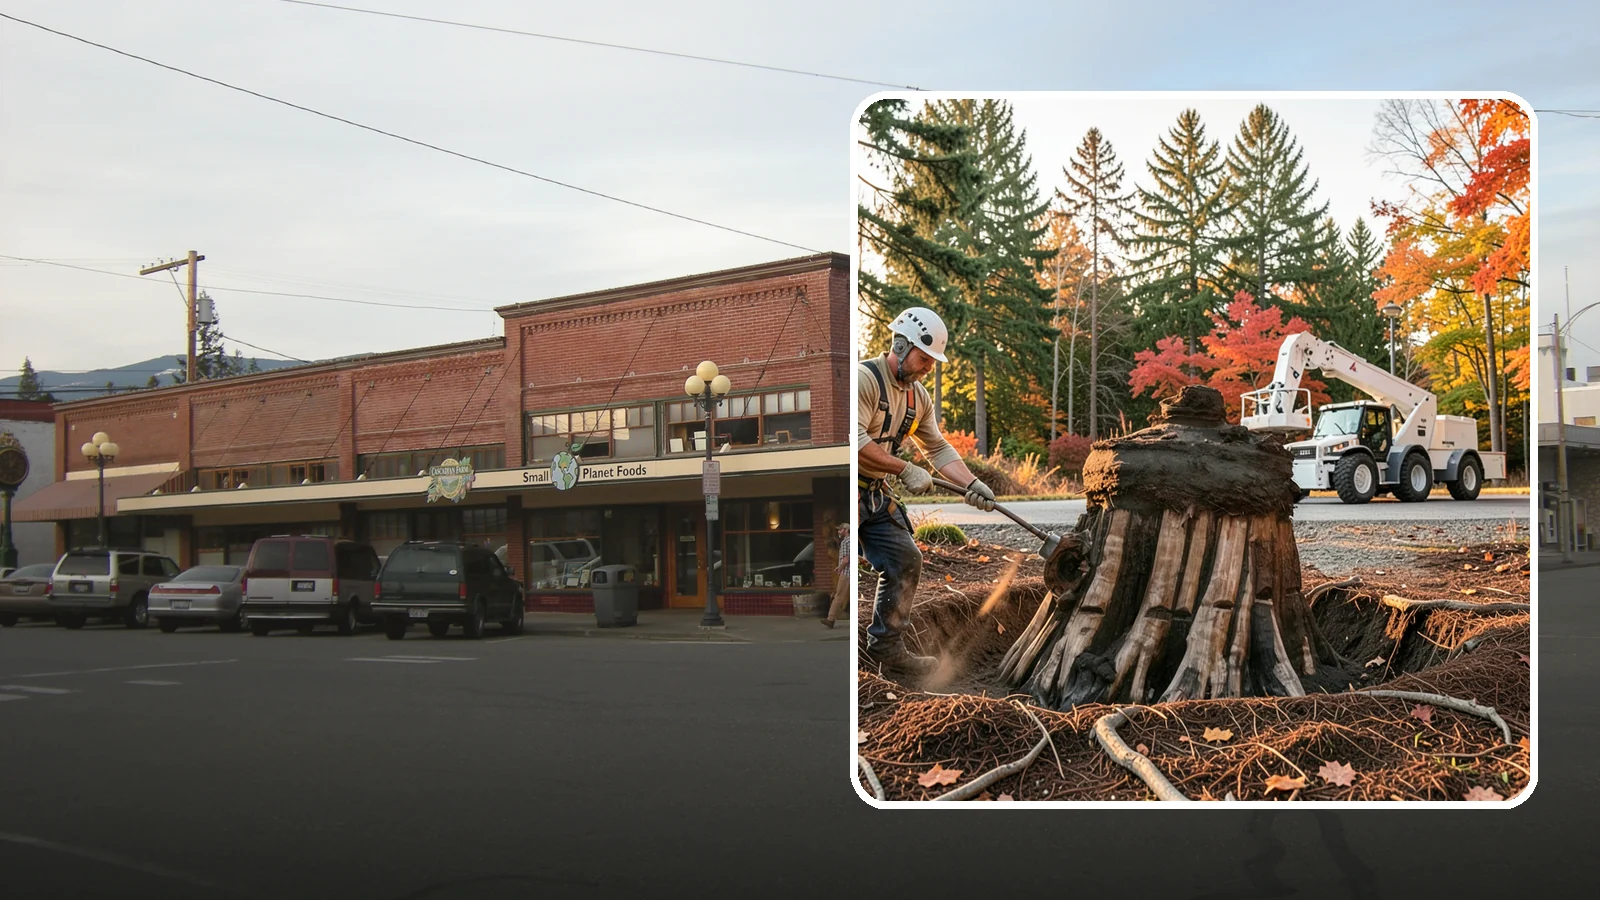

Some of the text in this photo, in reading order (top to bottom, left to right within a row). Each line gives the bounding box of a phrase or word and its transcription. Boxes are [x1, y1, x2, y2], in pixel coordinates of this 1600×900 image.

[523, 464, 647, 483] Small Planet Foods
